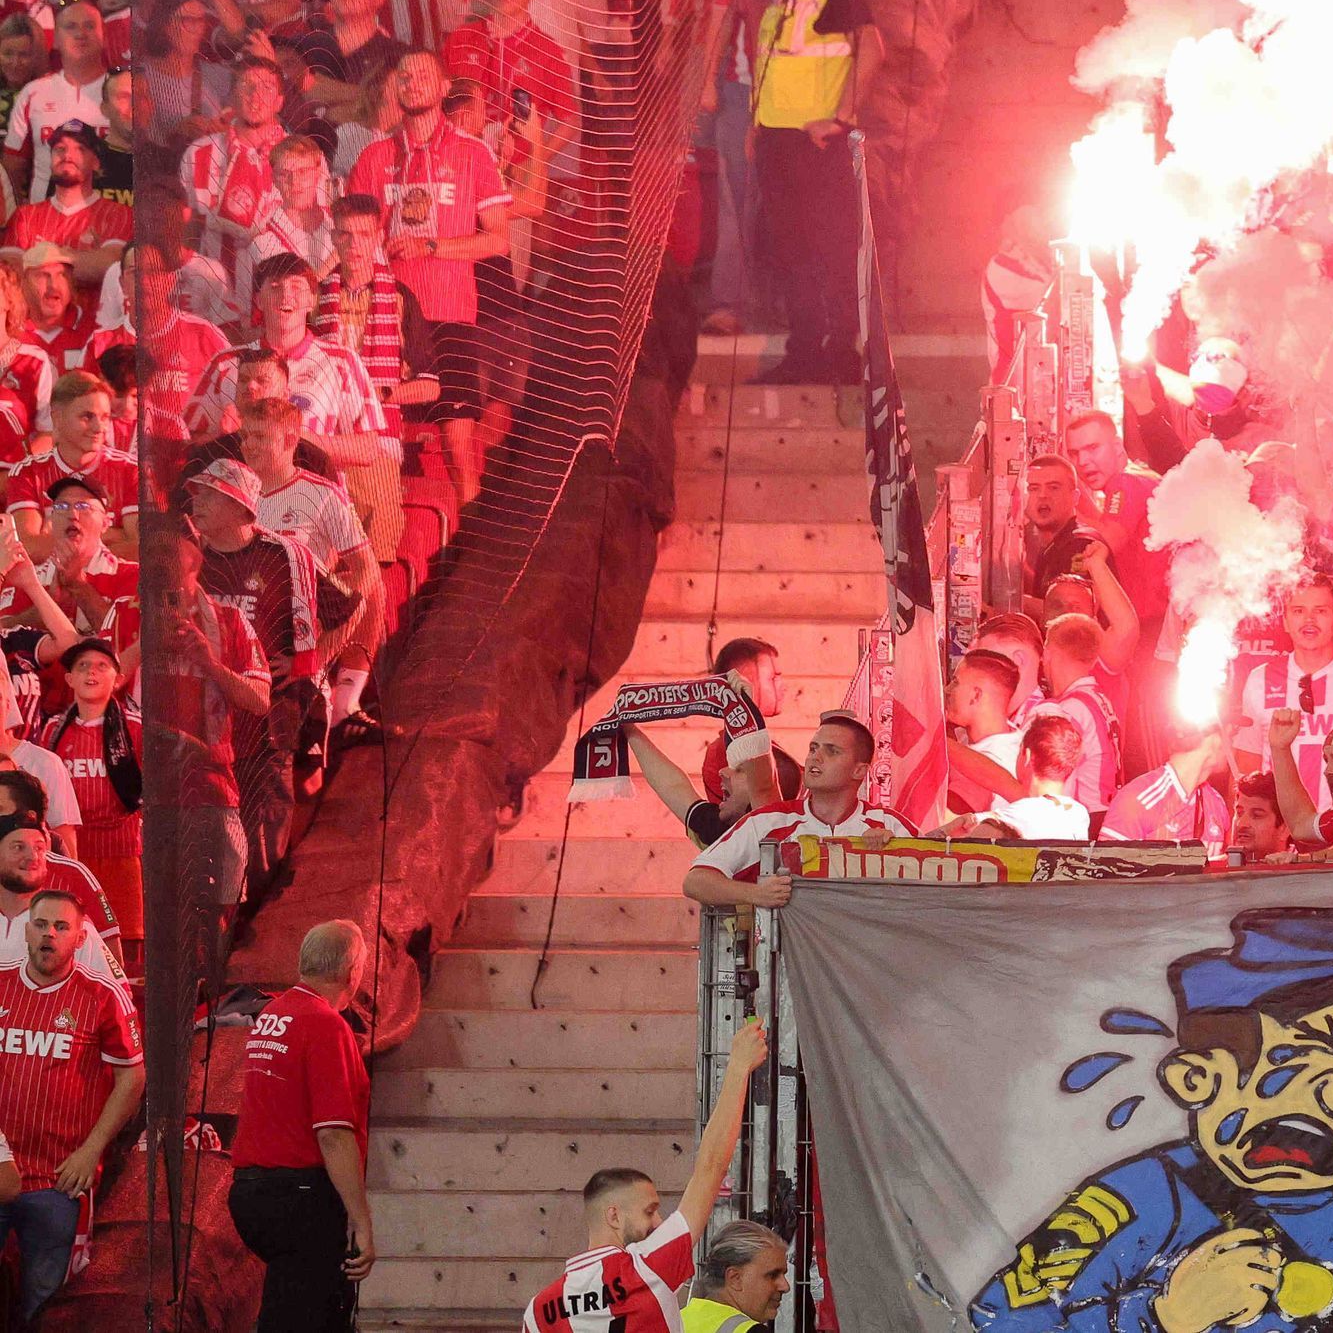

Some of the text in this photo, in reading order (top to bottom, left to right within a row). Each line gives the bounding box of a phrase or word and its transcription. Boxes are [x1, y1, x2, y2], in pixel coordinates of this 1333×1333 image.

[99, 894, 114, 922] DEVK
[128, 1019, 139, 1048] DEVK
[250, 1013, 293, 1037] SDS
[0, 1028, 73, 1059] EWE
[543, 1276, 628, 1325] ULTRAS
